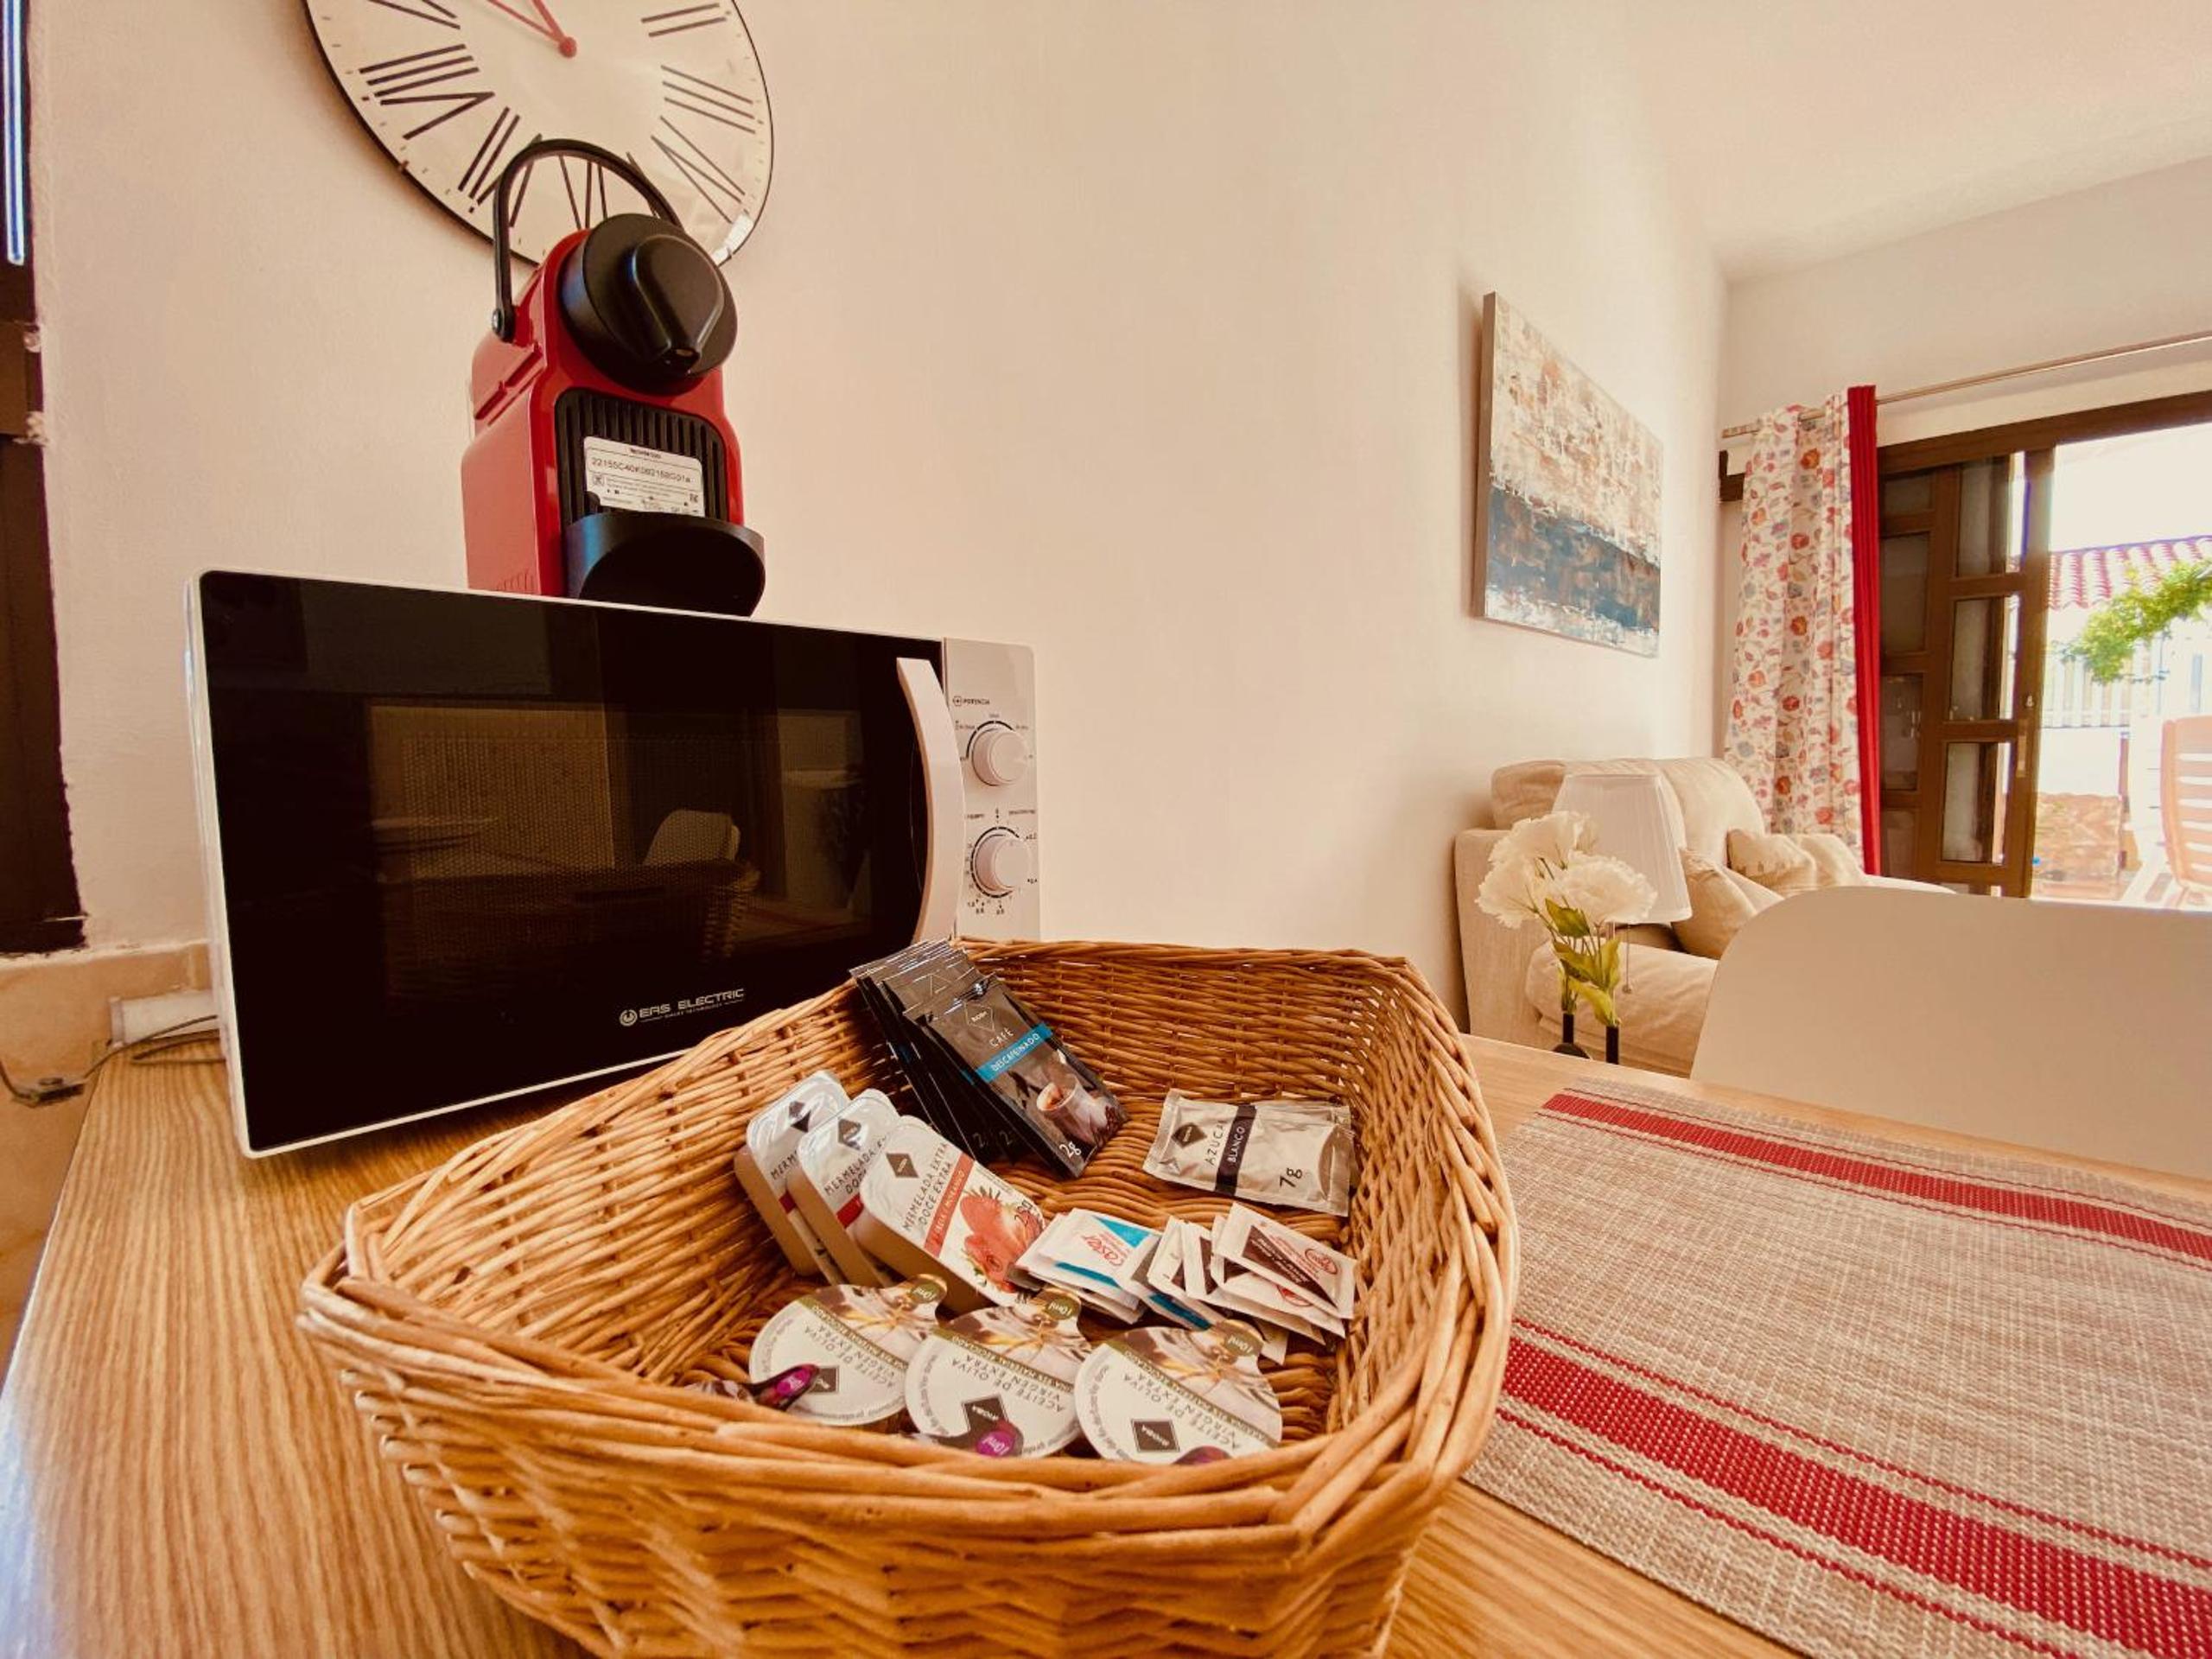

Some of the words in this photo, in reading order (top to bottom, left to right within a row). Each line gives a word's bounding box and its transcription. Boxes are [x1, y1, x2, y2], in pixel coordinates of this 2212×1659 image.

[639, 1003, 671, 1018] EAS
[677, 988, 744, 1010] ELECTRIC
[1226, 1127, 1245, 1163] BLANCO
[823, 1148, 875, 1196] MERMELADA
[1279, 1167, 1303, 1189] 7g
[903, 1173, 933, 1232] MERMELADA
[931, 1141, 948, 1171] EXTRA
[918, 1194, 938, 1225] DOCE
[933, 1162, 952, 1194] EXTRA
[1049, 1300, 1072, 1315] 10ml
[1228, 1336, 1253, 1354] 10ml
[951, 1358, 989, 1381] OLIVA
[966, 1354, 1007, 1377] EXTRA
[995, 1379, 1012, 1392] DE
[1011, 1376, 1060, 1402] VIRGEN
[1121, 1373, 1161, 1404] OLIVA
[1134, 1372, 1175, 1403] EXTRA
[1017, 1389, 1065, 1413] ACEITE
[1166, 1402, 1185, 1419] DE
[1183, 1403, 1236, 1439] VIRGEN
[1187, 1415, 1240, 1452] ACEITE
